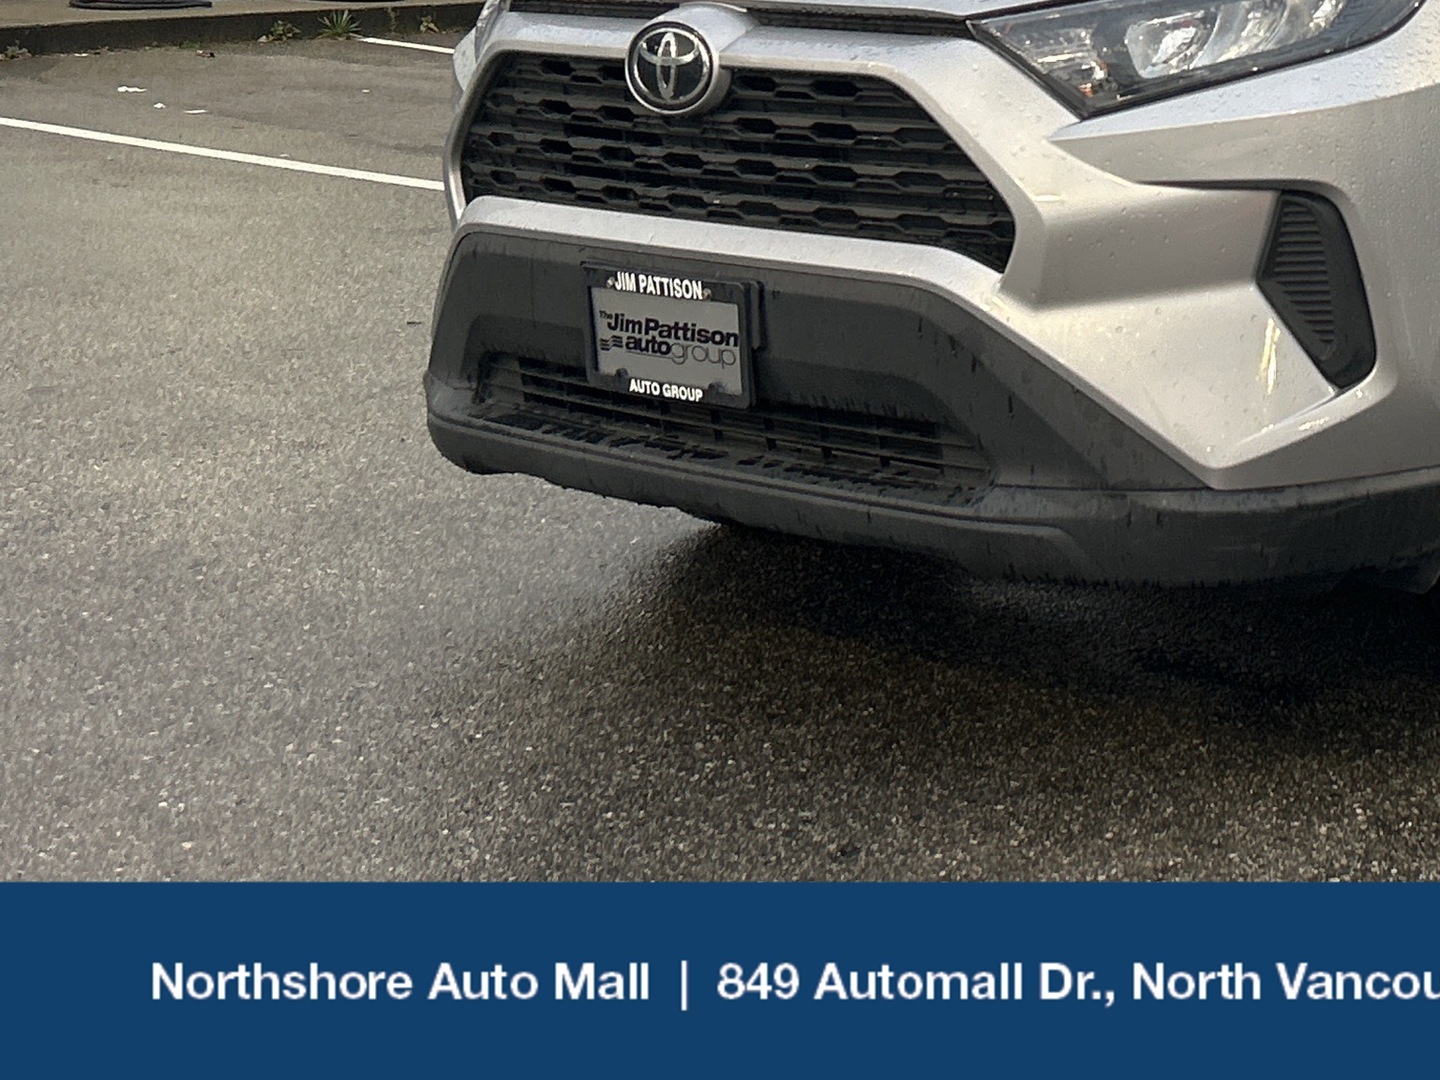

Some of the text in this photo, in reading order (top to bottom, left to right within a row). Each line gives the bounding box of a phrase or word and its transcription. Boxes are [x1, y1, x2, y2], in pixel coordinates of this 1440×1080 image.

[615, 271, 703, 300] JIM PATTISON
[599, 310, 739, 348] The Jim Pattison
[629, 378, 703, 402] AUTO GROUP
